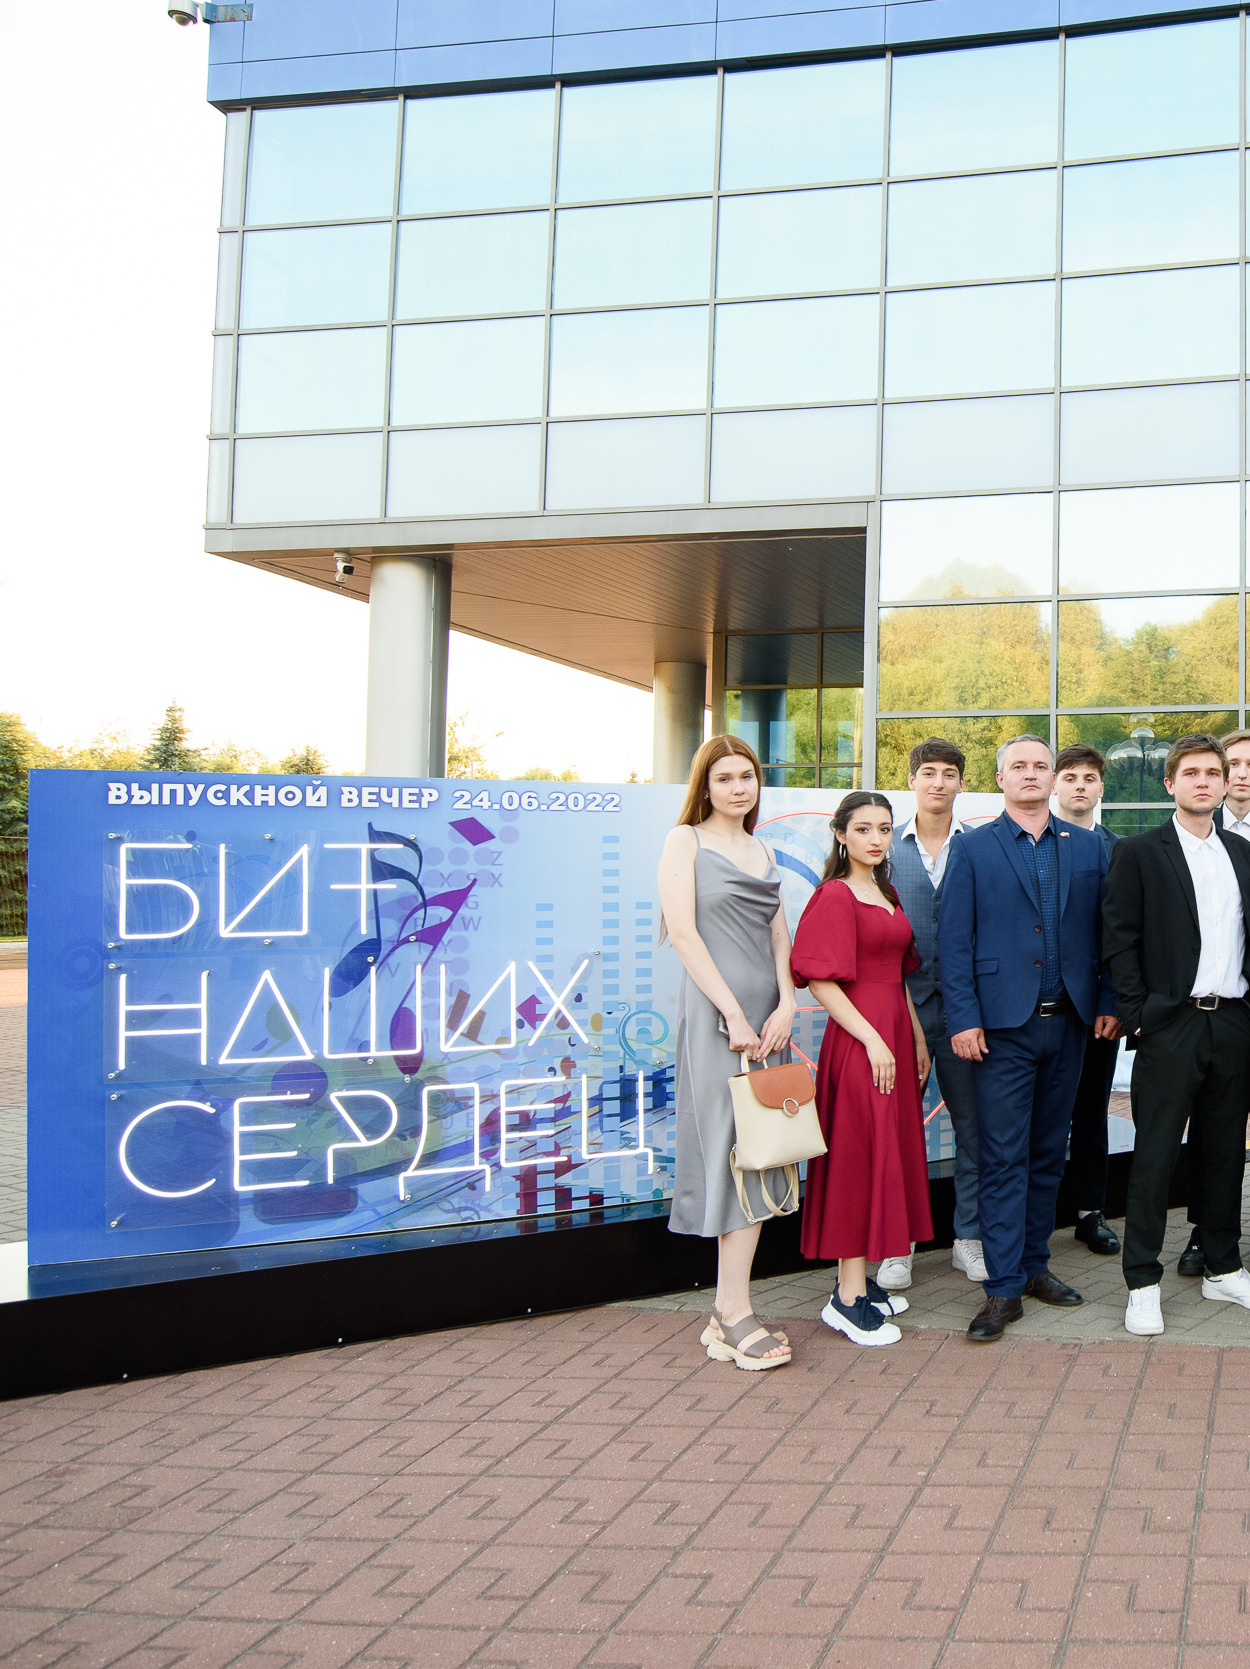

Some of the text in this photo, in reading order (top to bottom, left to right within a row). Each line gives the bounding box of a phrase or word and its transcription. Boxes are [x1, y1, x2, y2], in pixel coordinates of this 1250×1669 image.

[107, 780, 621, 811] ВЫПУСКНОЙ ВЕЧЕР 24.06.2022
[119, 842, 405, 939] БИТ
[118, 959, 592, 1070] НАШИХ
[118, 1070, 654, 1200] СЕРДЕЦ
